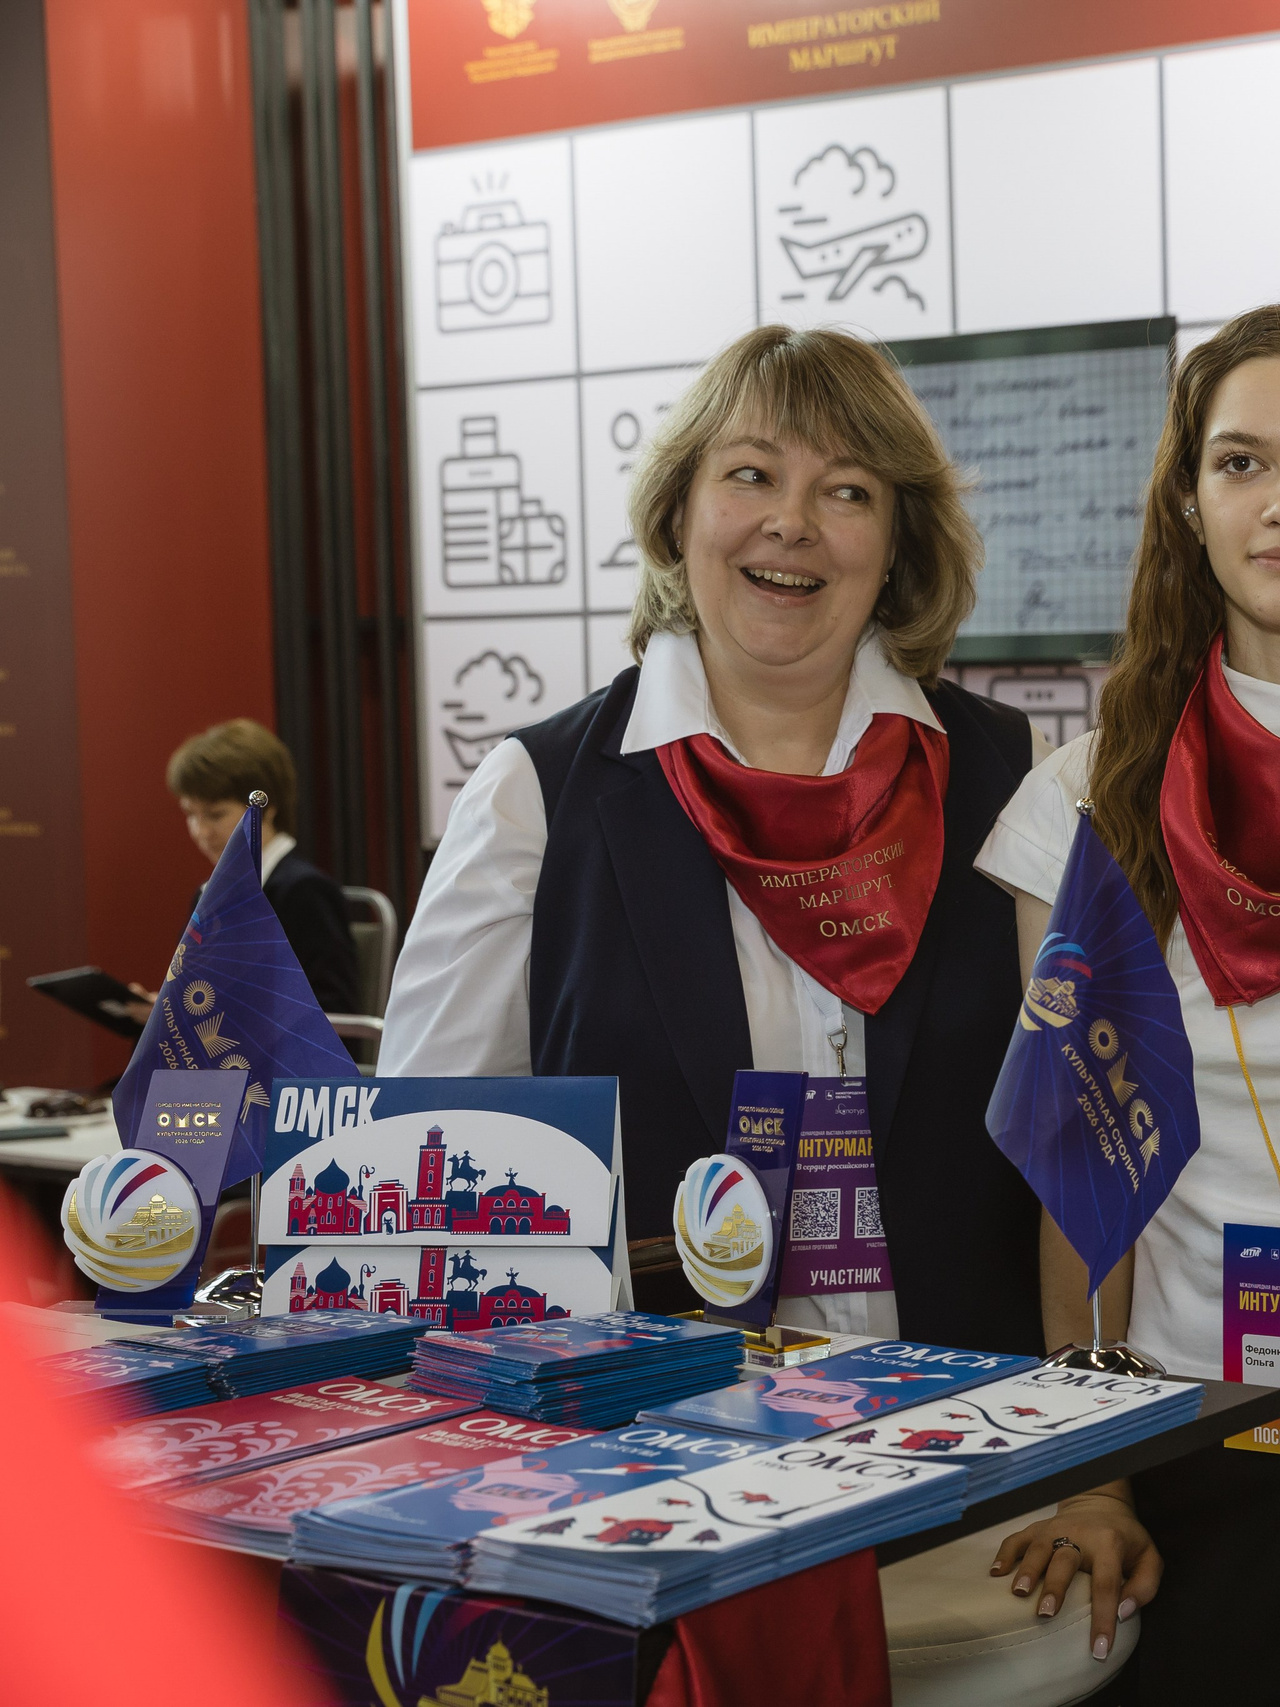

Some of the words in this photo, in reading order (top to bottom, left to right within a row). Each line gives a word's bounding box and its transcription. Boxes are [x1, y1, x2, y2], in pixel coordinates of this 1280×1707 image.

[758, 839, 904, 888] ИМПЕРАТОРСКИЙ
[799, 874, 895, 910] МАРШРУТ
[1061, 1043, 1116, 1128] КУЛЬТУРНАЯ
[156, 1112, 221, 1128] ОМСК
[275, 1086, 381, 1139] ОМСК
[739, 1116, 785, 1136] ОМСК
[1077, 1093, 1100, 1127] 2026
[1095, 1126, 1116, 1167] ГОДА
[810, 1267, 882, 1286] УЧАСТНИК
[870, 1344, 1013, 1369] ОМСК
[1245, 1356, 1274, 1367] Ольга
[317, 1383, 452, 1413] ОМСК
[1031, 1371, 1177, 1396] ОМСК
[618, 1429, 770, 1459] ОМСК
